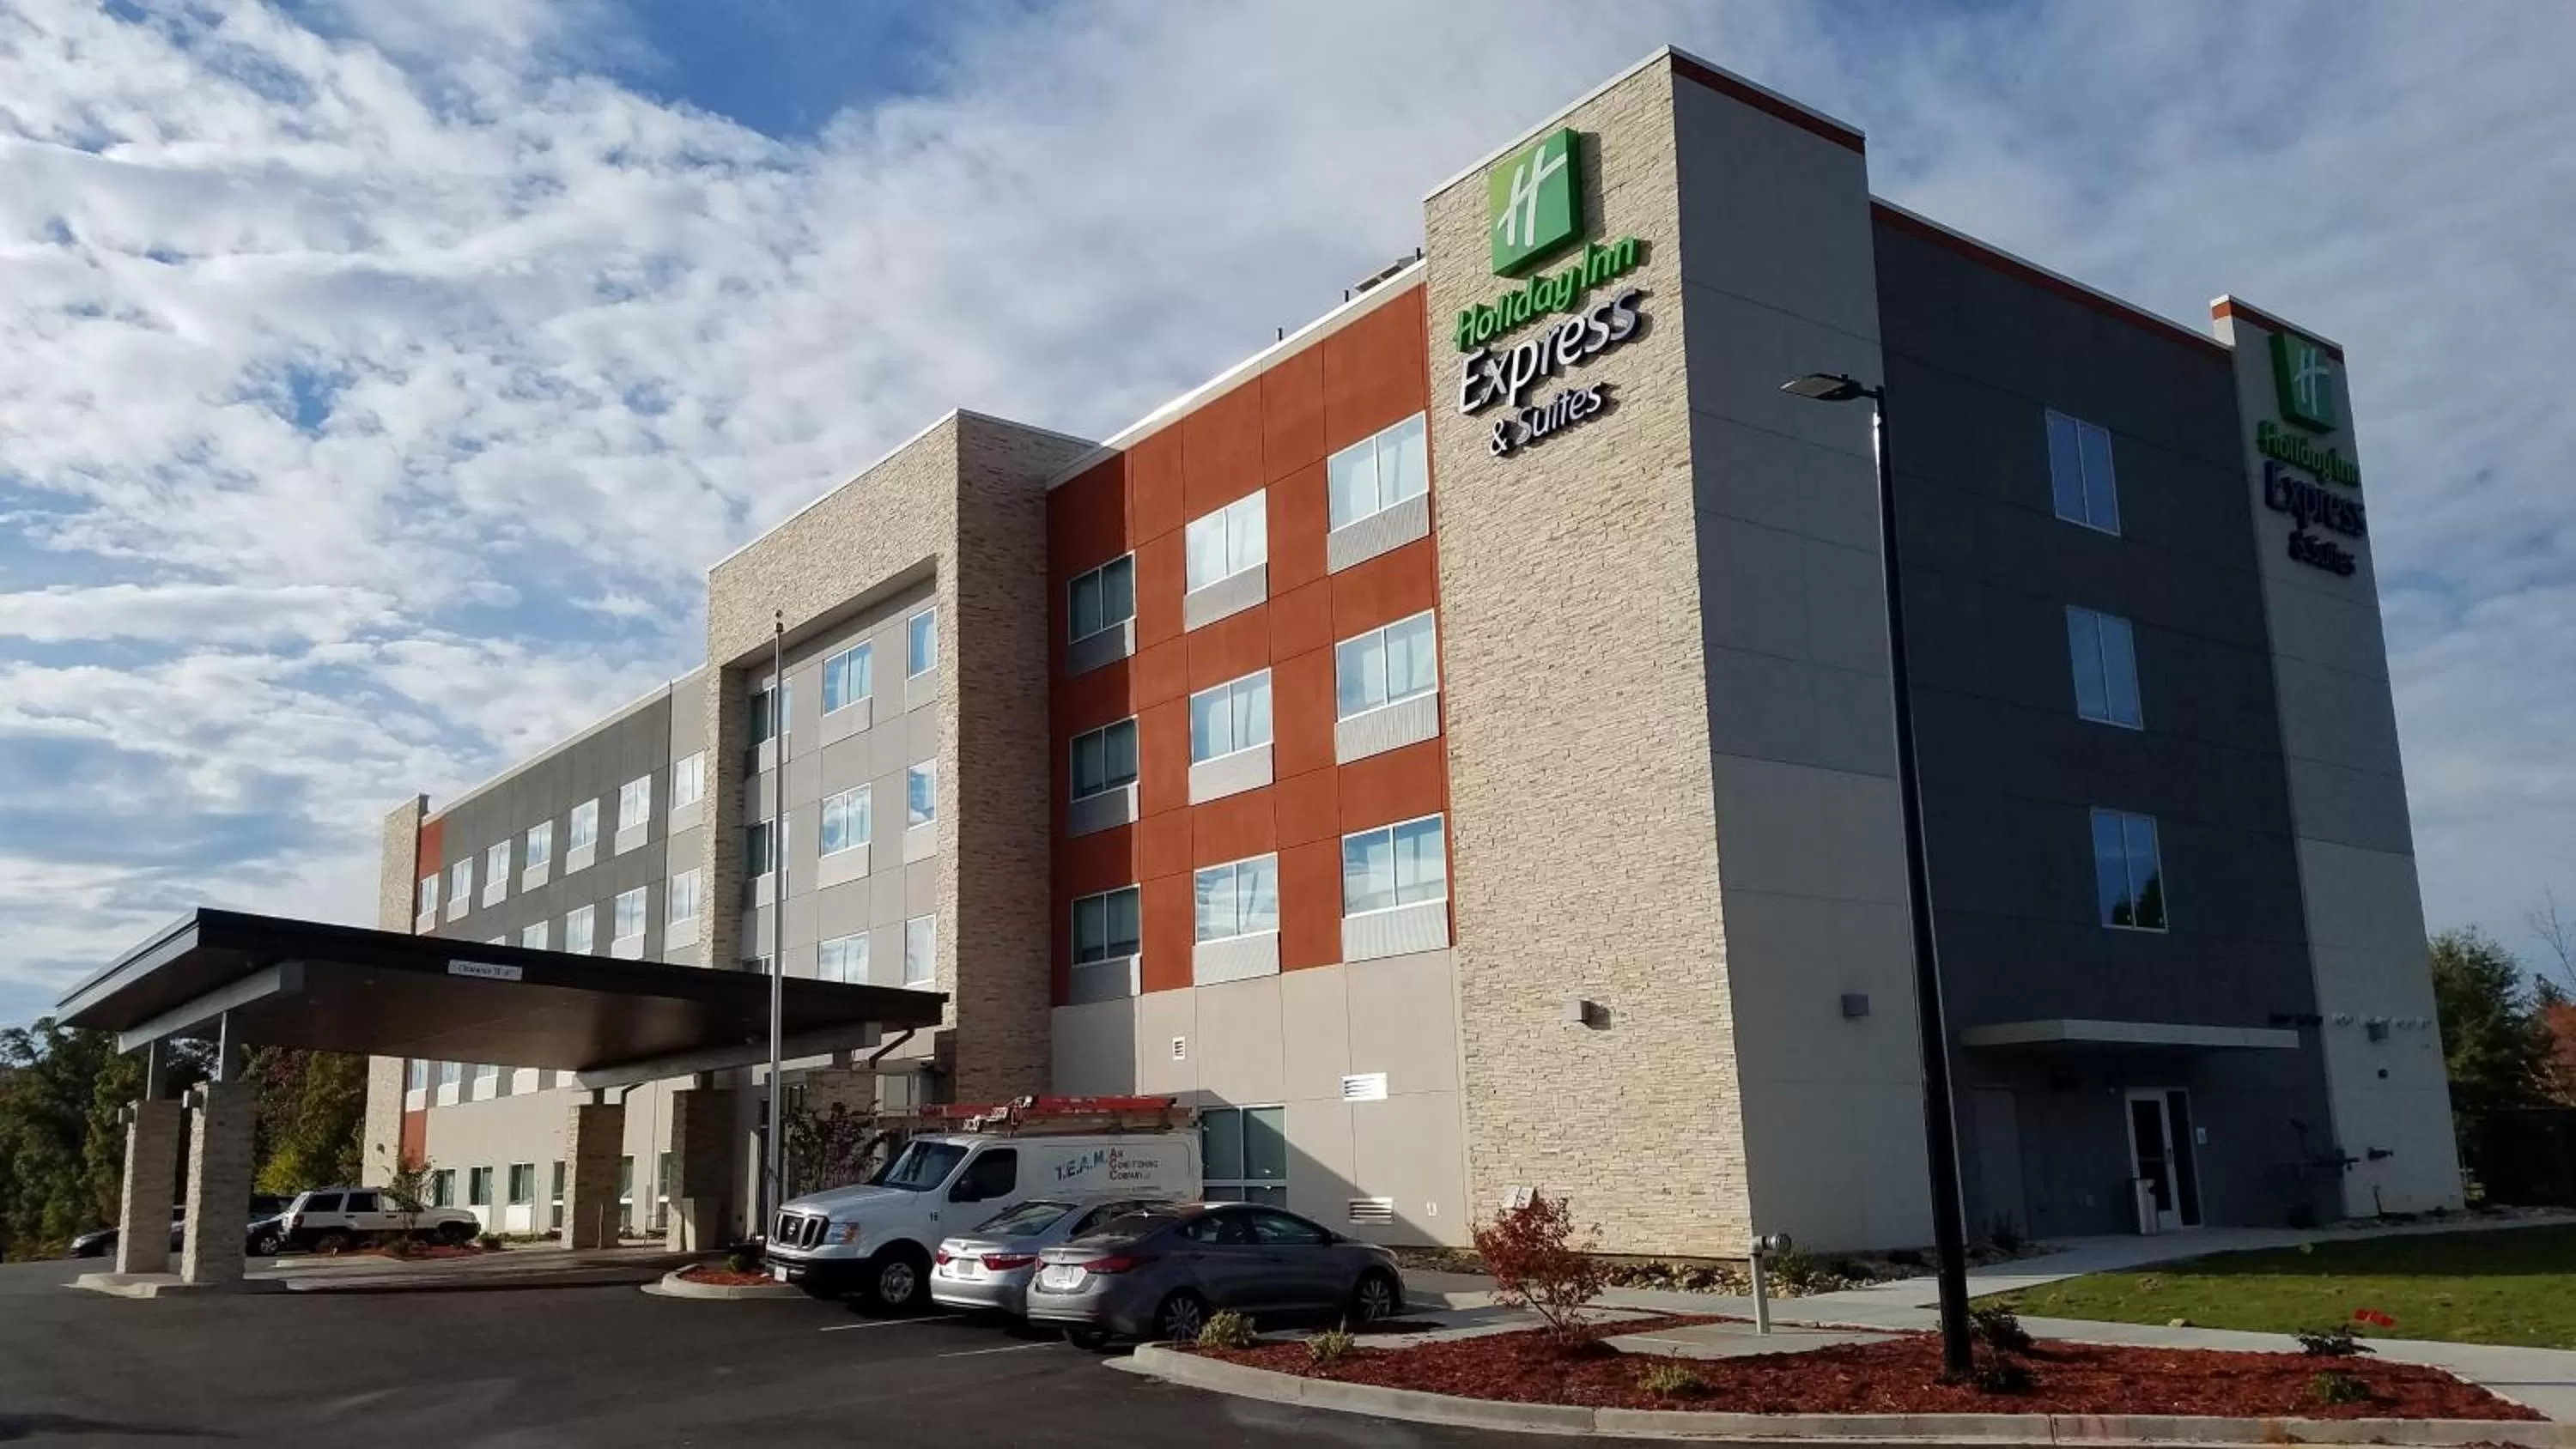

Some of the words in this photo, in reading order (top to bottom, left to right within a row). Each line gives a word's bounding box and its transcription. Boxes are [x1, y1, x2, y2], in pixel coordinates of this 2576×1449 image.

[1456, 267, 1578, 350] Holiday
[1581, 234, 1638, 288] Inn
[1460, 286, 1640, 415] Express
[1489, 418, 1511, 457] &
[1516, 381, 1607, 446] Suites
